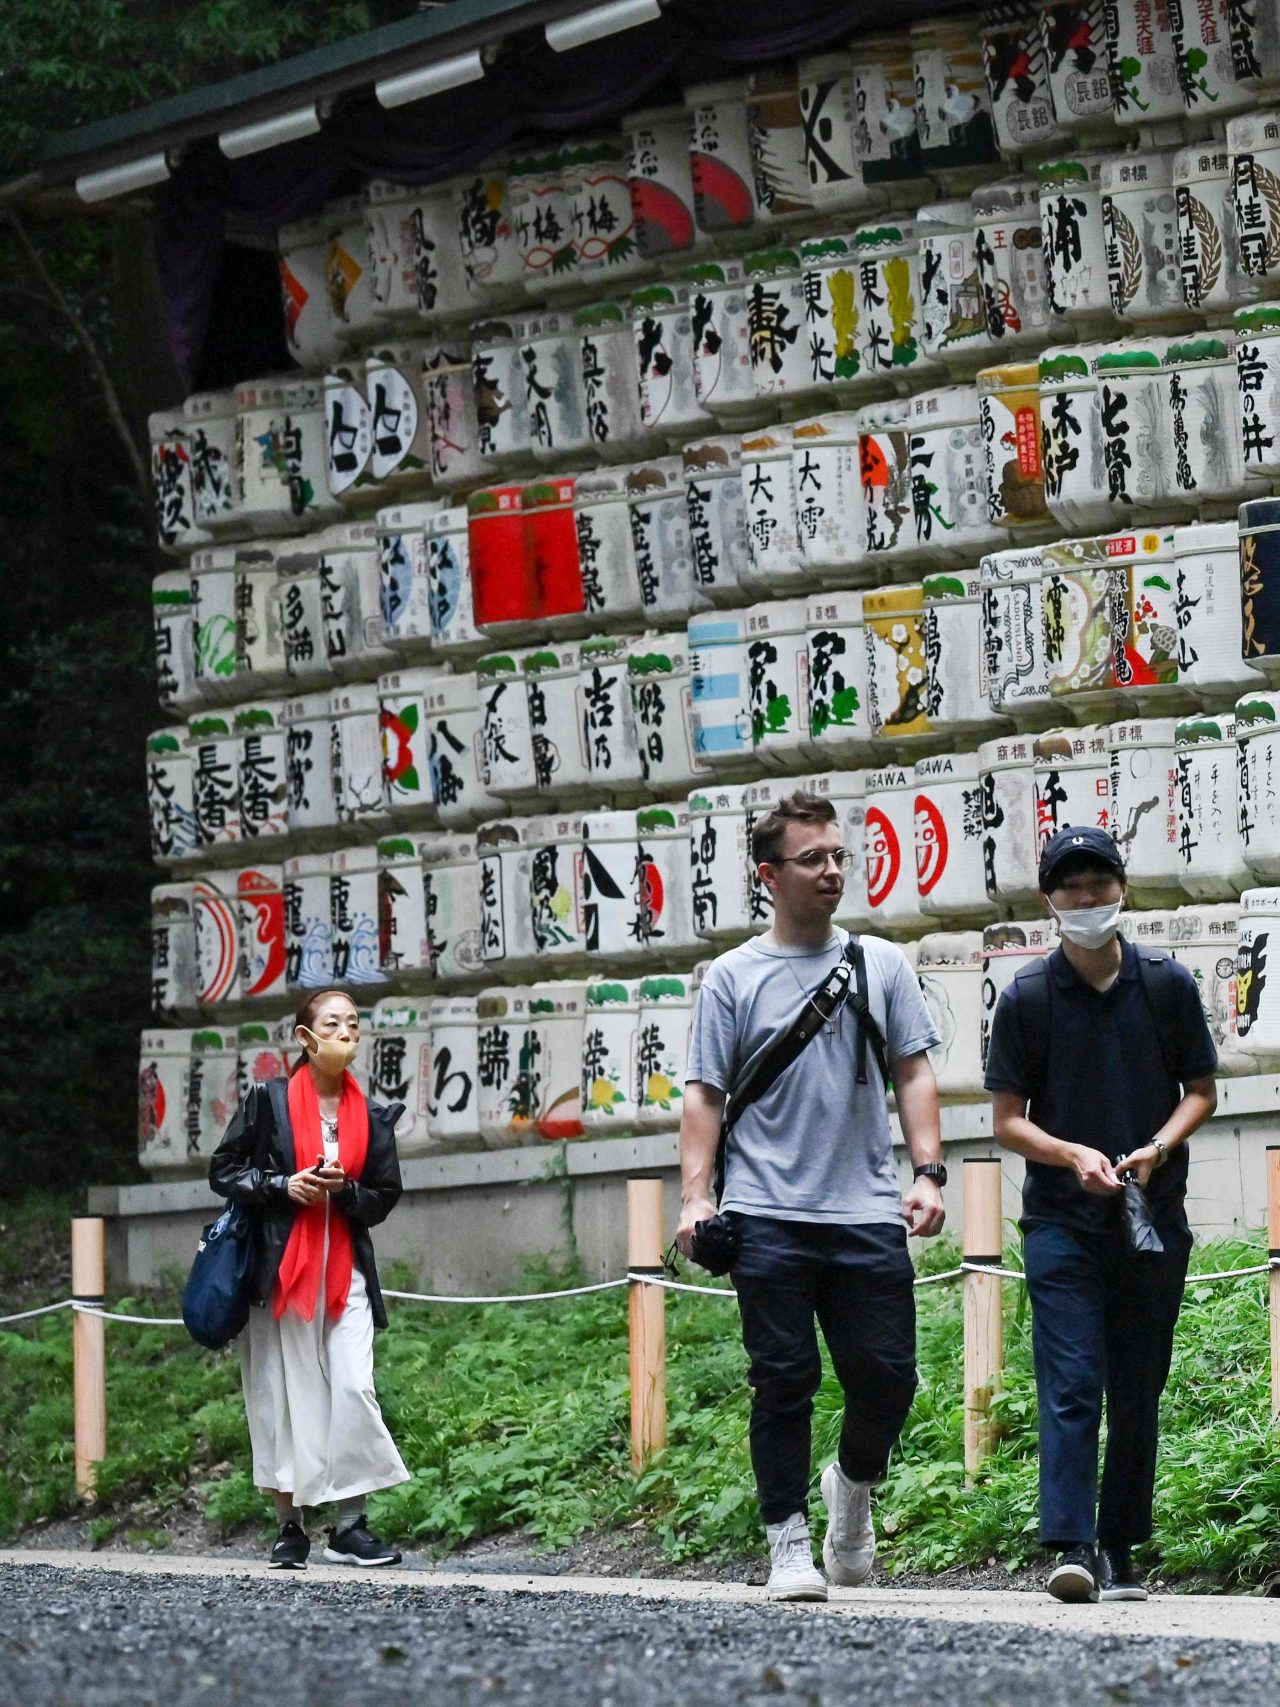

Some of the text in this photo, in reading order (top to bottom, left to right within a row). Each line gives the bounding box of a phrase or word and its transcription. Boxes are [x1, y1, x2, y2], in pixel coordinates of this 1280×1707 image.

[1120, 164, 1148, 182] 商標
[1199, 154, 1229, 172] 商標
[1233, 154, 1268, 277] 月桂冠
[803, 271, 835, 382] 東光
[860, 260, 893, 368] 東光
[1237, 344, 1275, 464] 岩の井
[749, 464, 778, 551] 大雪
[799, 451, 824, 540] 大雪
[997, 744, 1027, 761] 商標
[1072, 738, 1106, 755] 商標
[1118, 725, 1143, 741] 商標
[480, 862, 501, 949] 老松
